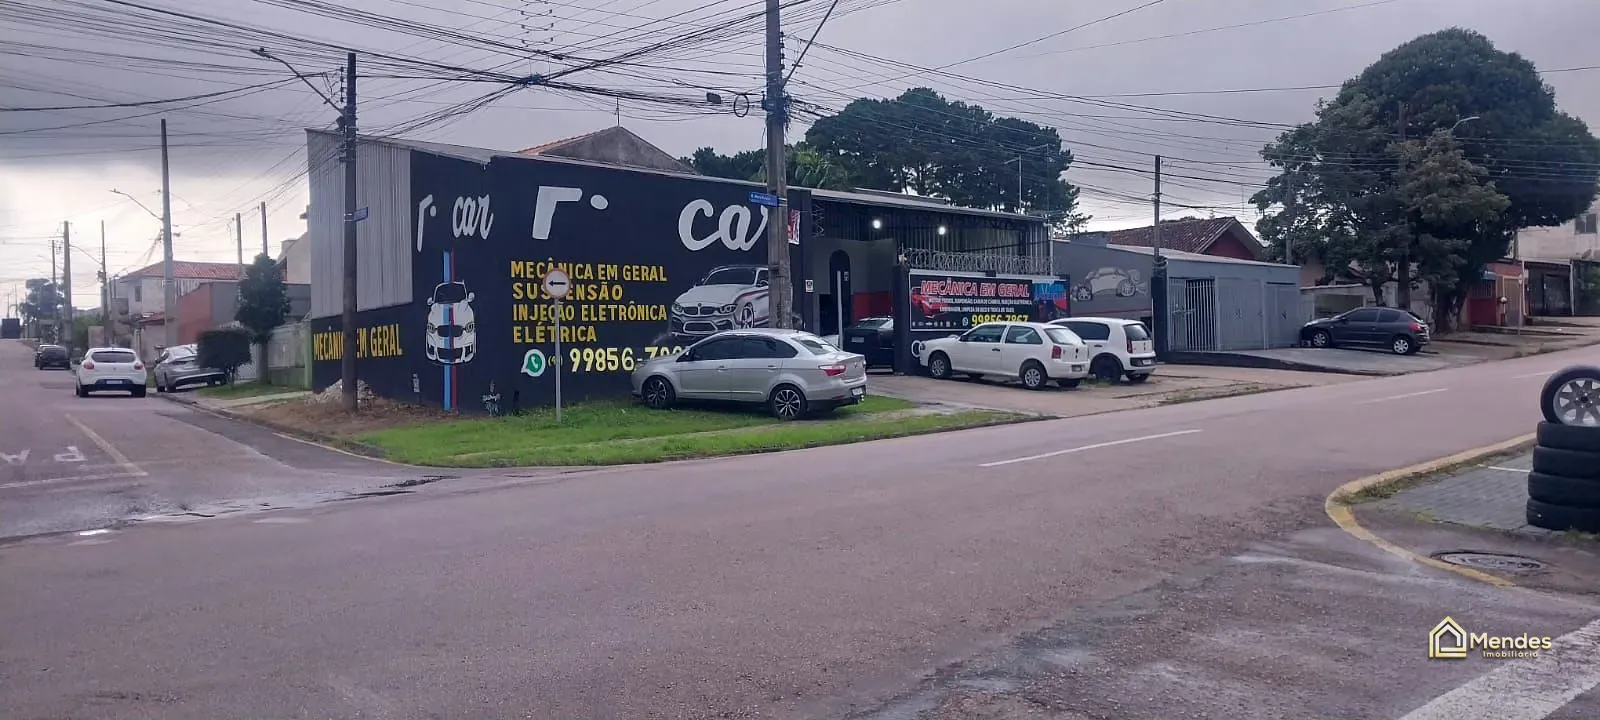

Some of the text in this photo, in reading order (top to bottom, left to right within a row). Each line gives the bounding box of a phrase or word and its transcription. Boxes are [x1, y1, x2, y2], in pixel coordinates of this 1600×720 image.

[452, 194, 494, 239] car
[678, 198, 769, 251] ca
[597, 263, 619, 281] EM
[622, 265, 668, 282] GERAL
[512, 282, 623, 301] SUSENSÃO
[920, 278, 978, 297] MECÂNICA
[979, 282, 997, 296] EM
[998, 283, 1030, 298] GERAL
[581, 301, 668, 322] ELETRÔNICA
[313, 325, 345, 361] MECÂNI
[370, 323, 403, 357] GERAL
[513, 321, 597, 344] ELÉTRICA
[569, 345, 682, 373] 99856-7
